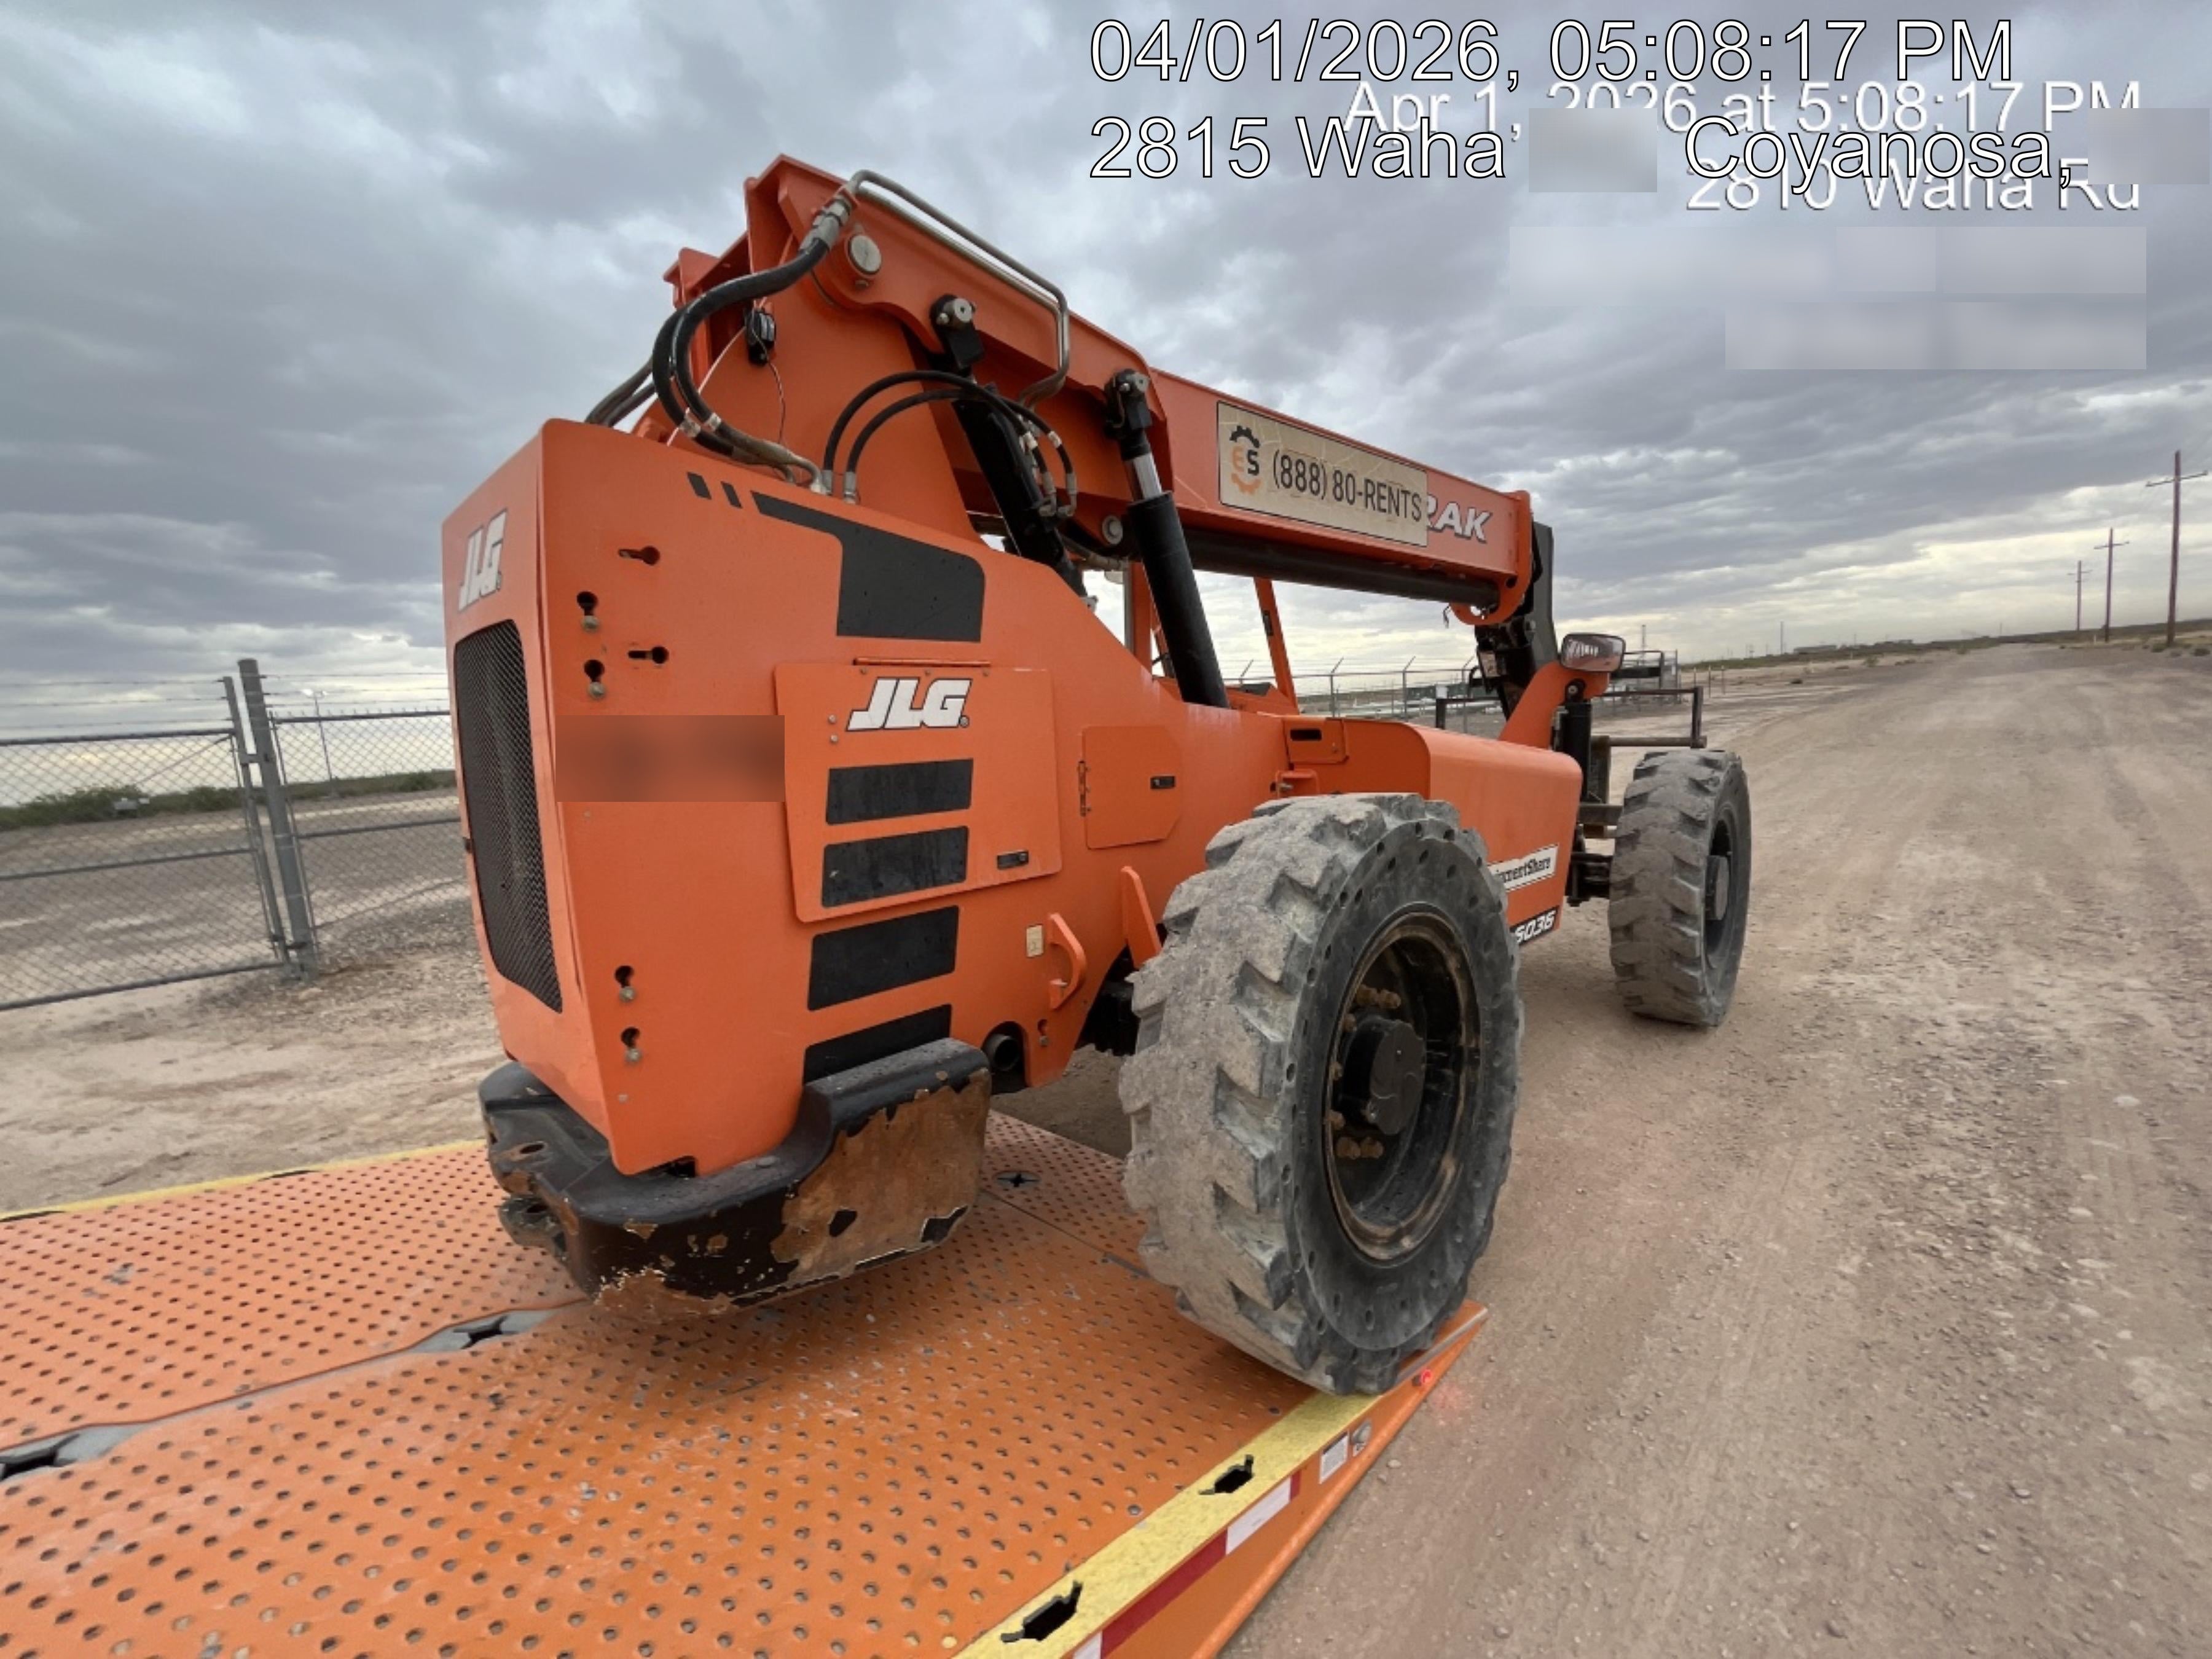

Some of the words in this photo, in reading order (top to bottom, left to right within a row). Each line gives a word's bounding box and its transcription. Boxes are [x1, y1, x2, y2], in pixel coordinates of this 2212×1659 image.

[1273, 449, 1327, 500] (888)
[1332, 469, 1422, 522] 80-RENTS
[459, 508, 508, 612] JLG
[845, 677, 971, 732] JLG
